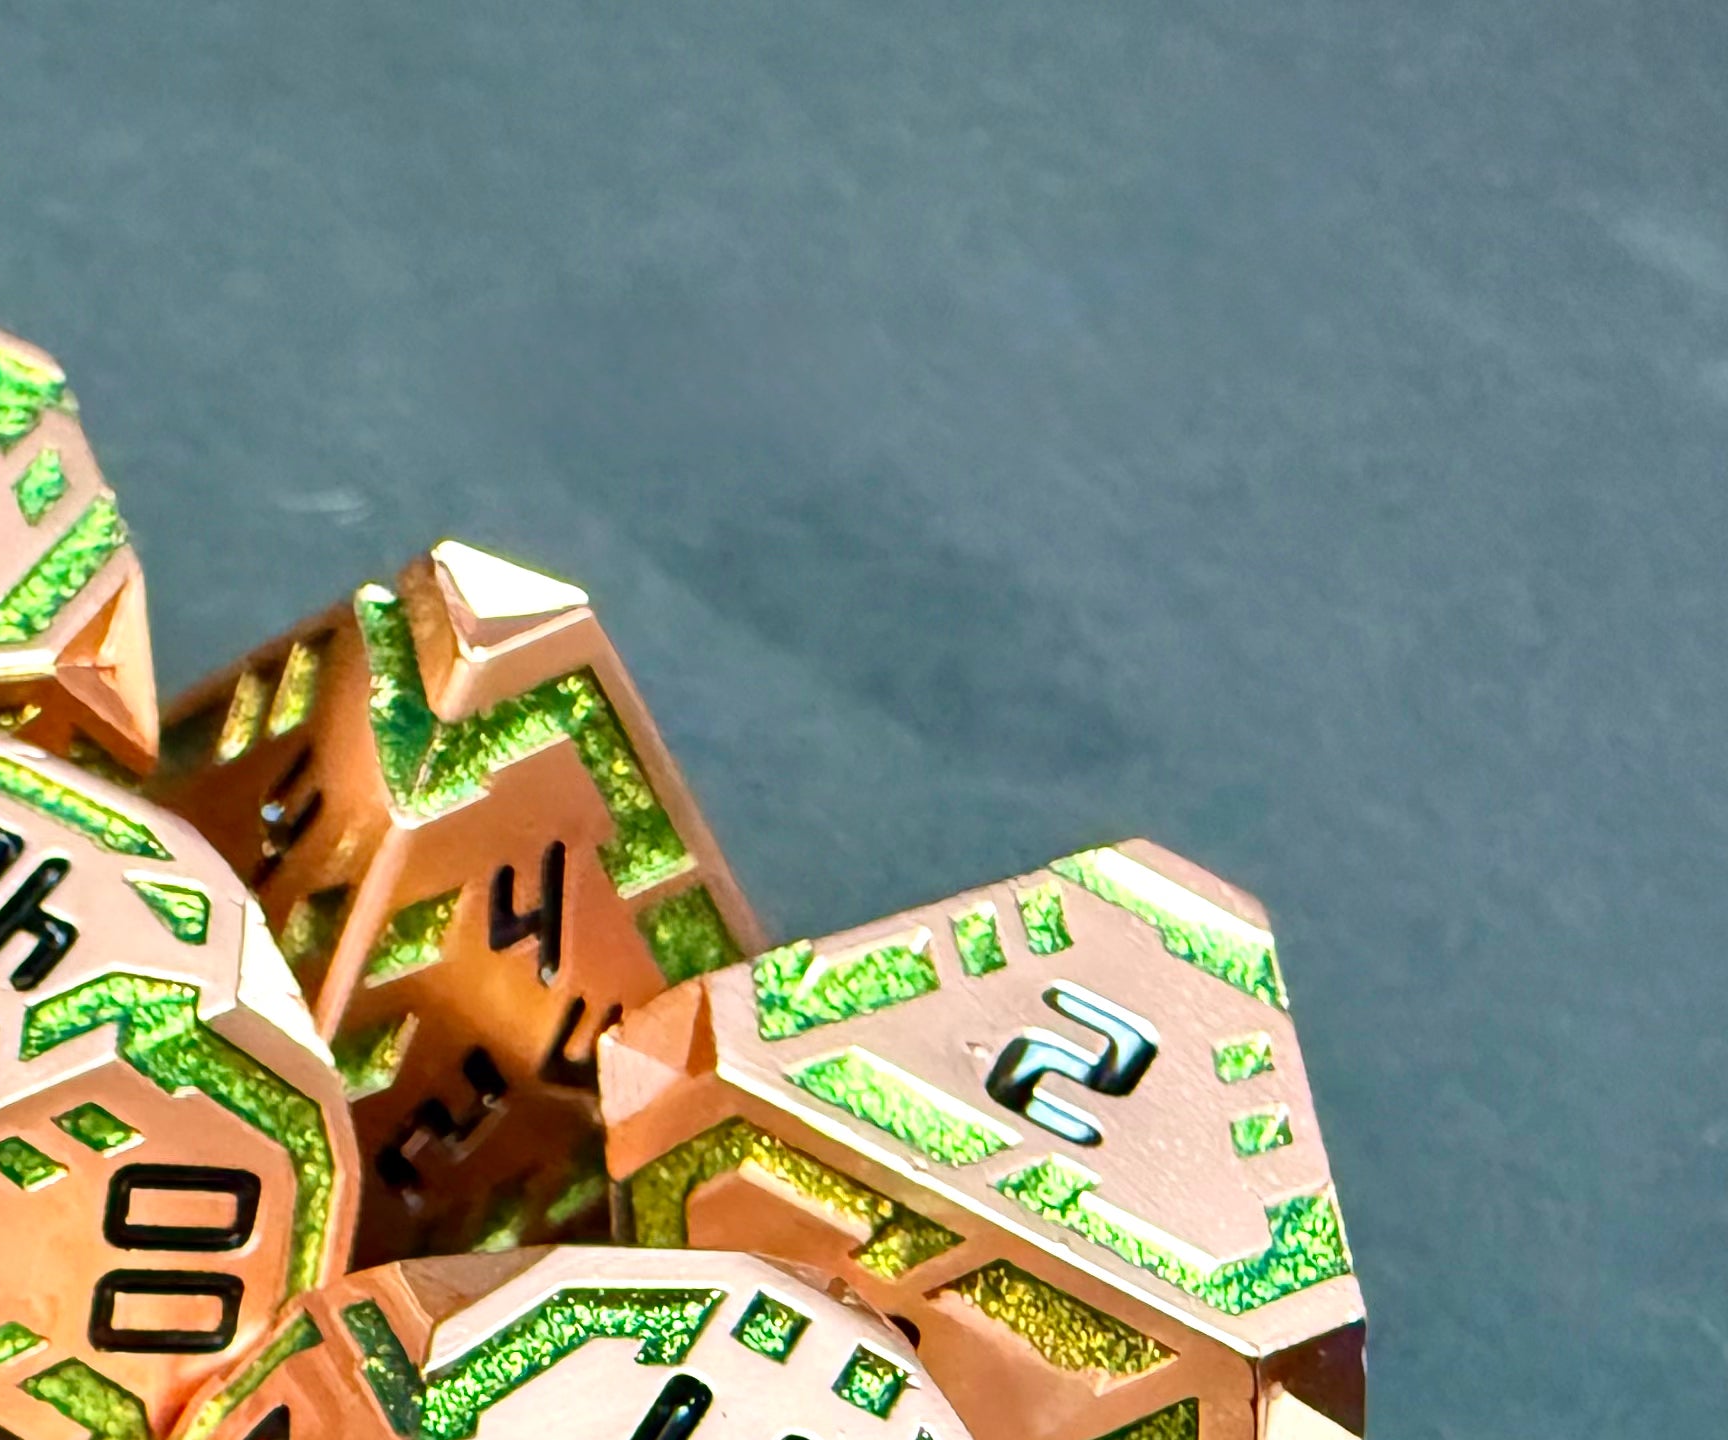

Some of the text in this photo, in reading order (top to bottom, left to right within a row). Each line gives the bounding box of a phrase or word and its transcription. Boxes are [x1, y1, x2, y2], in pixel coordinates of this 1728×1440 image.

[488, 841, 566, 984] 4
[985, 978, 1160, 1148] 2
[88, 1163, 262, 1354] 00
